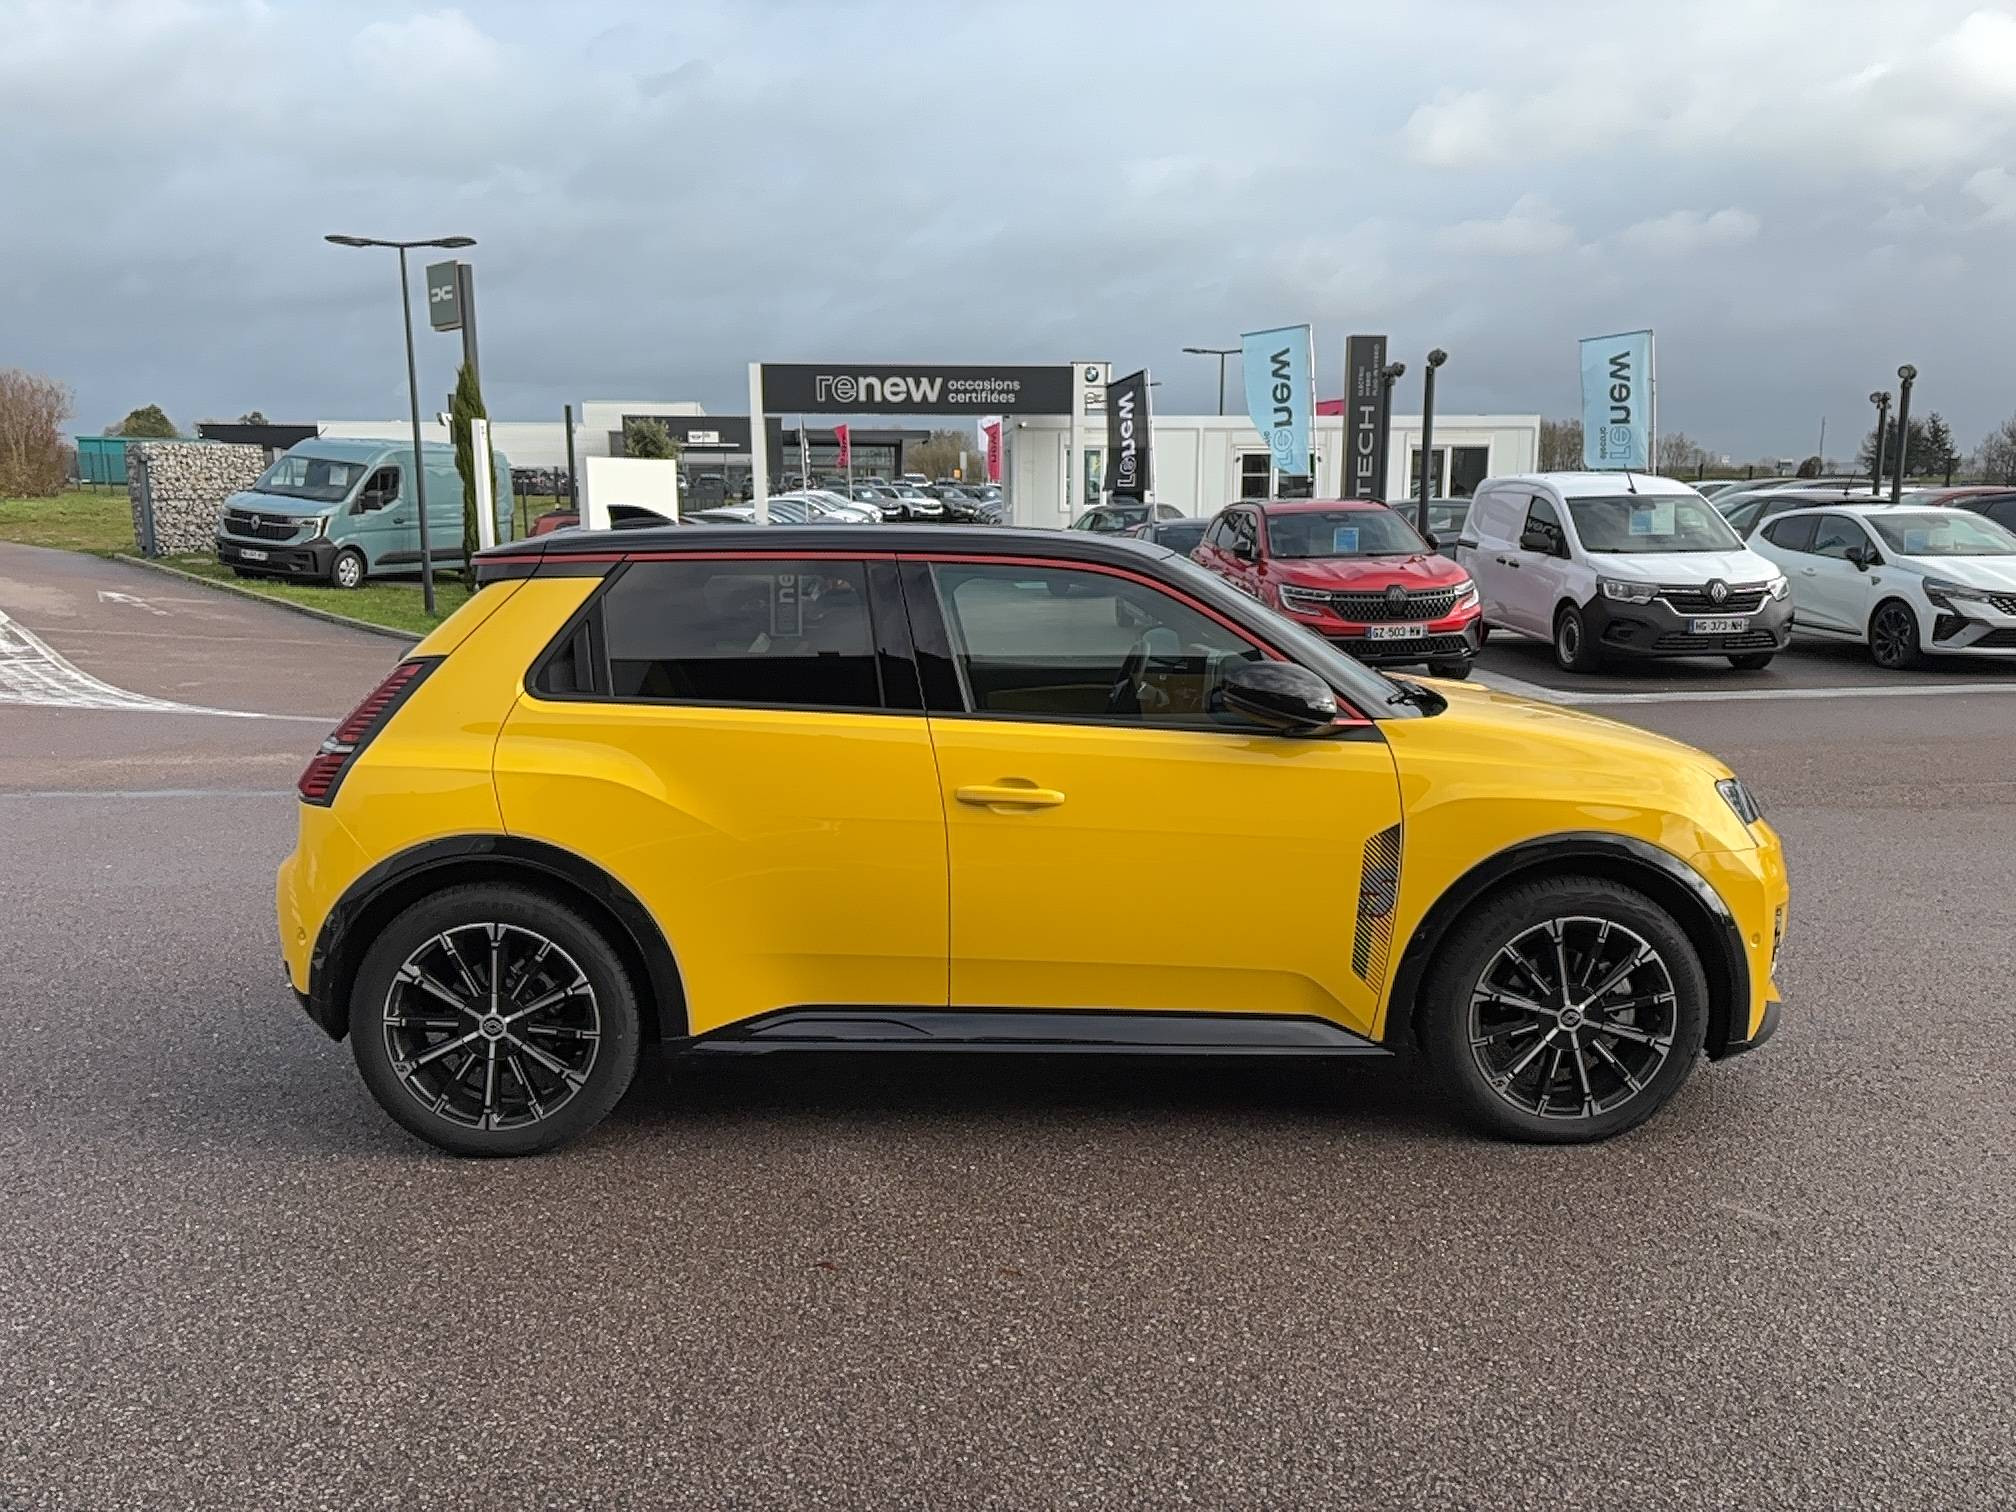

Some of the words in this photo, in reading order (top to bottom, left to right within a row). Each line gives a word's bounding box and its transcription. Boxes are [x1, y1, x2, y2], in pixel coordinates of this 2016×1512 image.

[816, 375, 943, 403] renew
[947, 377, 1020, 390] occasions
[947, 390, 1016, 403] certifiées
